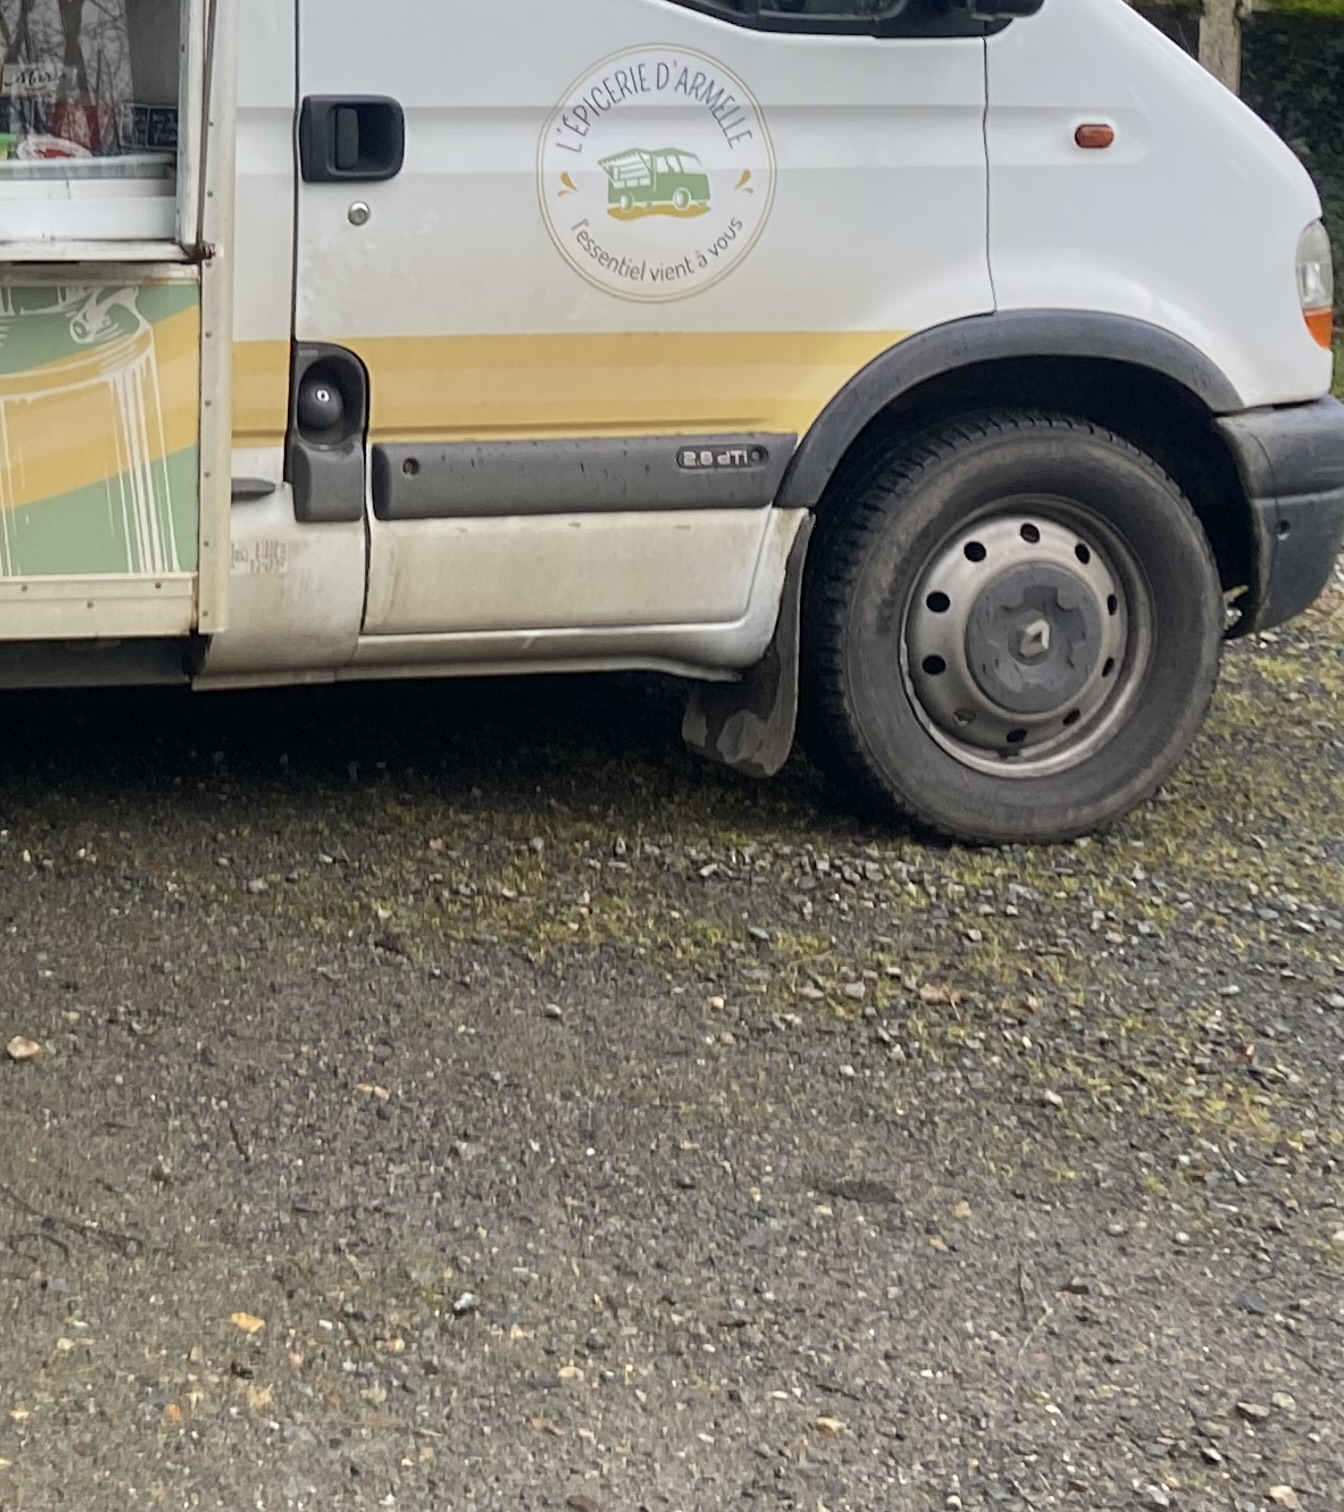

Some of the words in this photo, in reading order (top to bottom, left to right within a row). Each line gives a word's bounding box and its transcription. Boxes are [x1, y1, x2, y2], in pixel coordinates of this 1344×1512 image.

[656, 60, 754, 150] D'ARMELLE
[570, 217, 646, 282] l'essentiel
[649, 255, 695, 283] vient
[697, 249, 710, 268] à
[708, 216, 744, 258] vous
